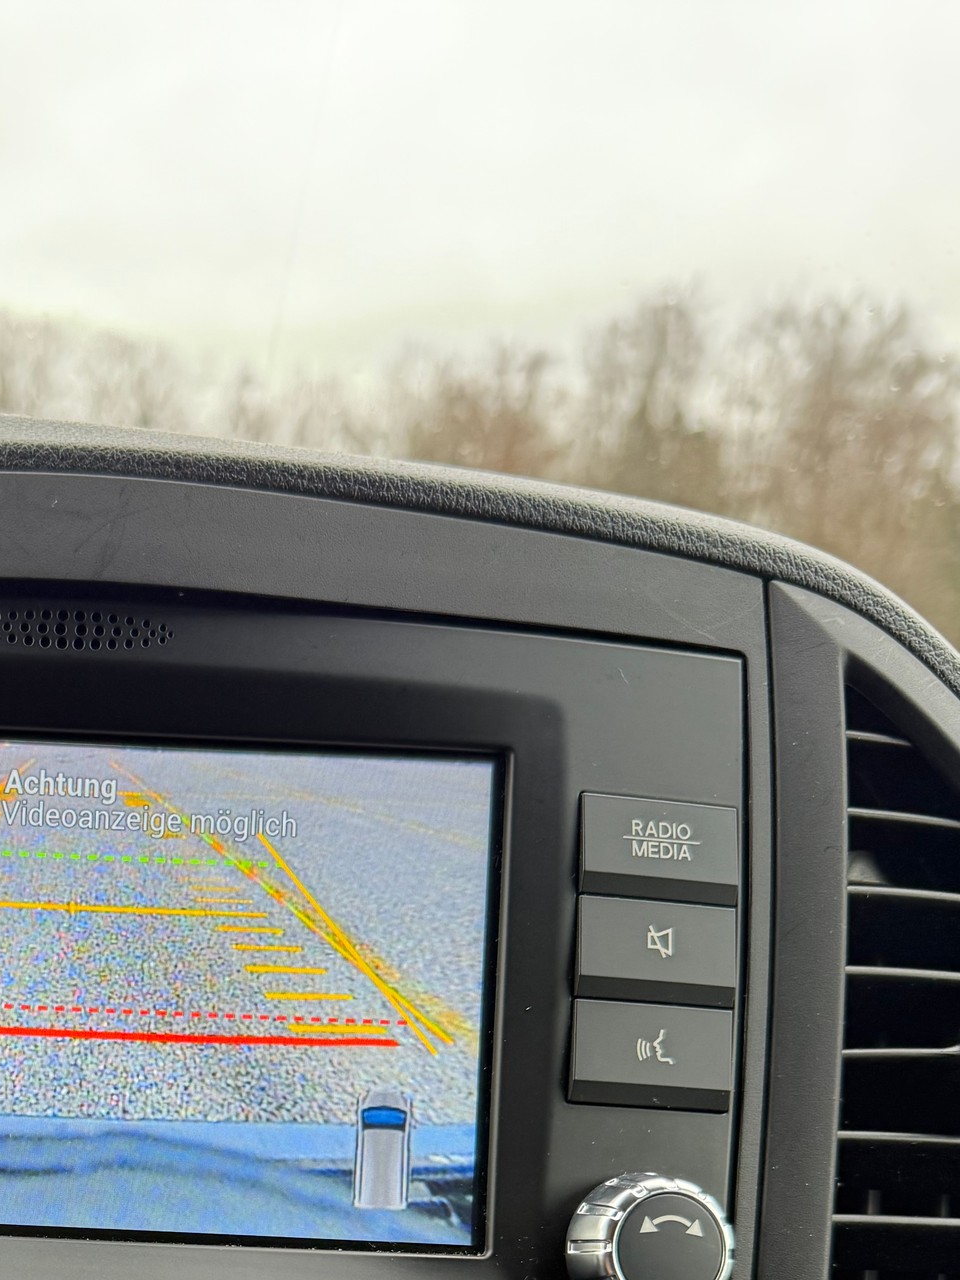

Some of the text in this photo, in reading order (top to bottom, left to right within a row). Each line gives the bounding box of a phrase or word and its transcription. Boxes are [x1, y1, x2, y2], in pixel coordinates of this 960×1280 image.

[4, 769, 118, 805] Achtung
[2, 799, 182, 839] Videoanzeige
[190, 809, 298, 842] möglich
[631, 819, 691, 840] RADIO
[631, 840, 692, 862] MEDIA
